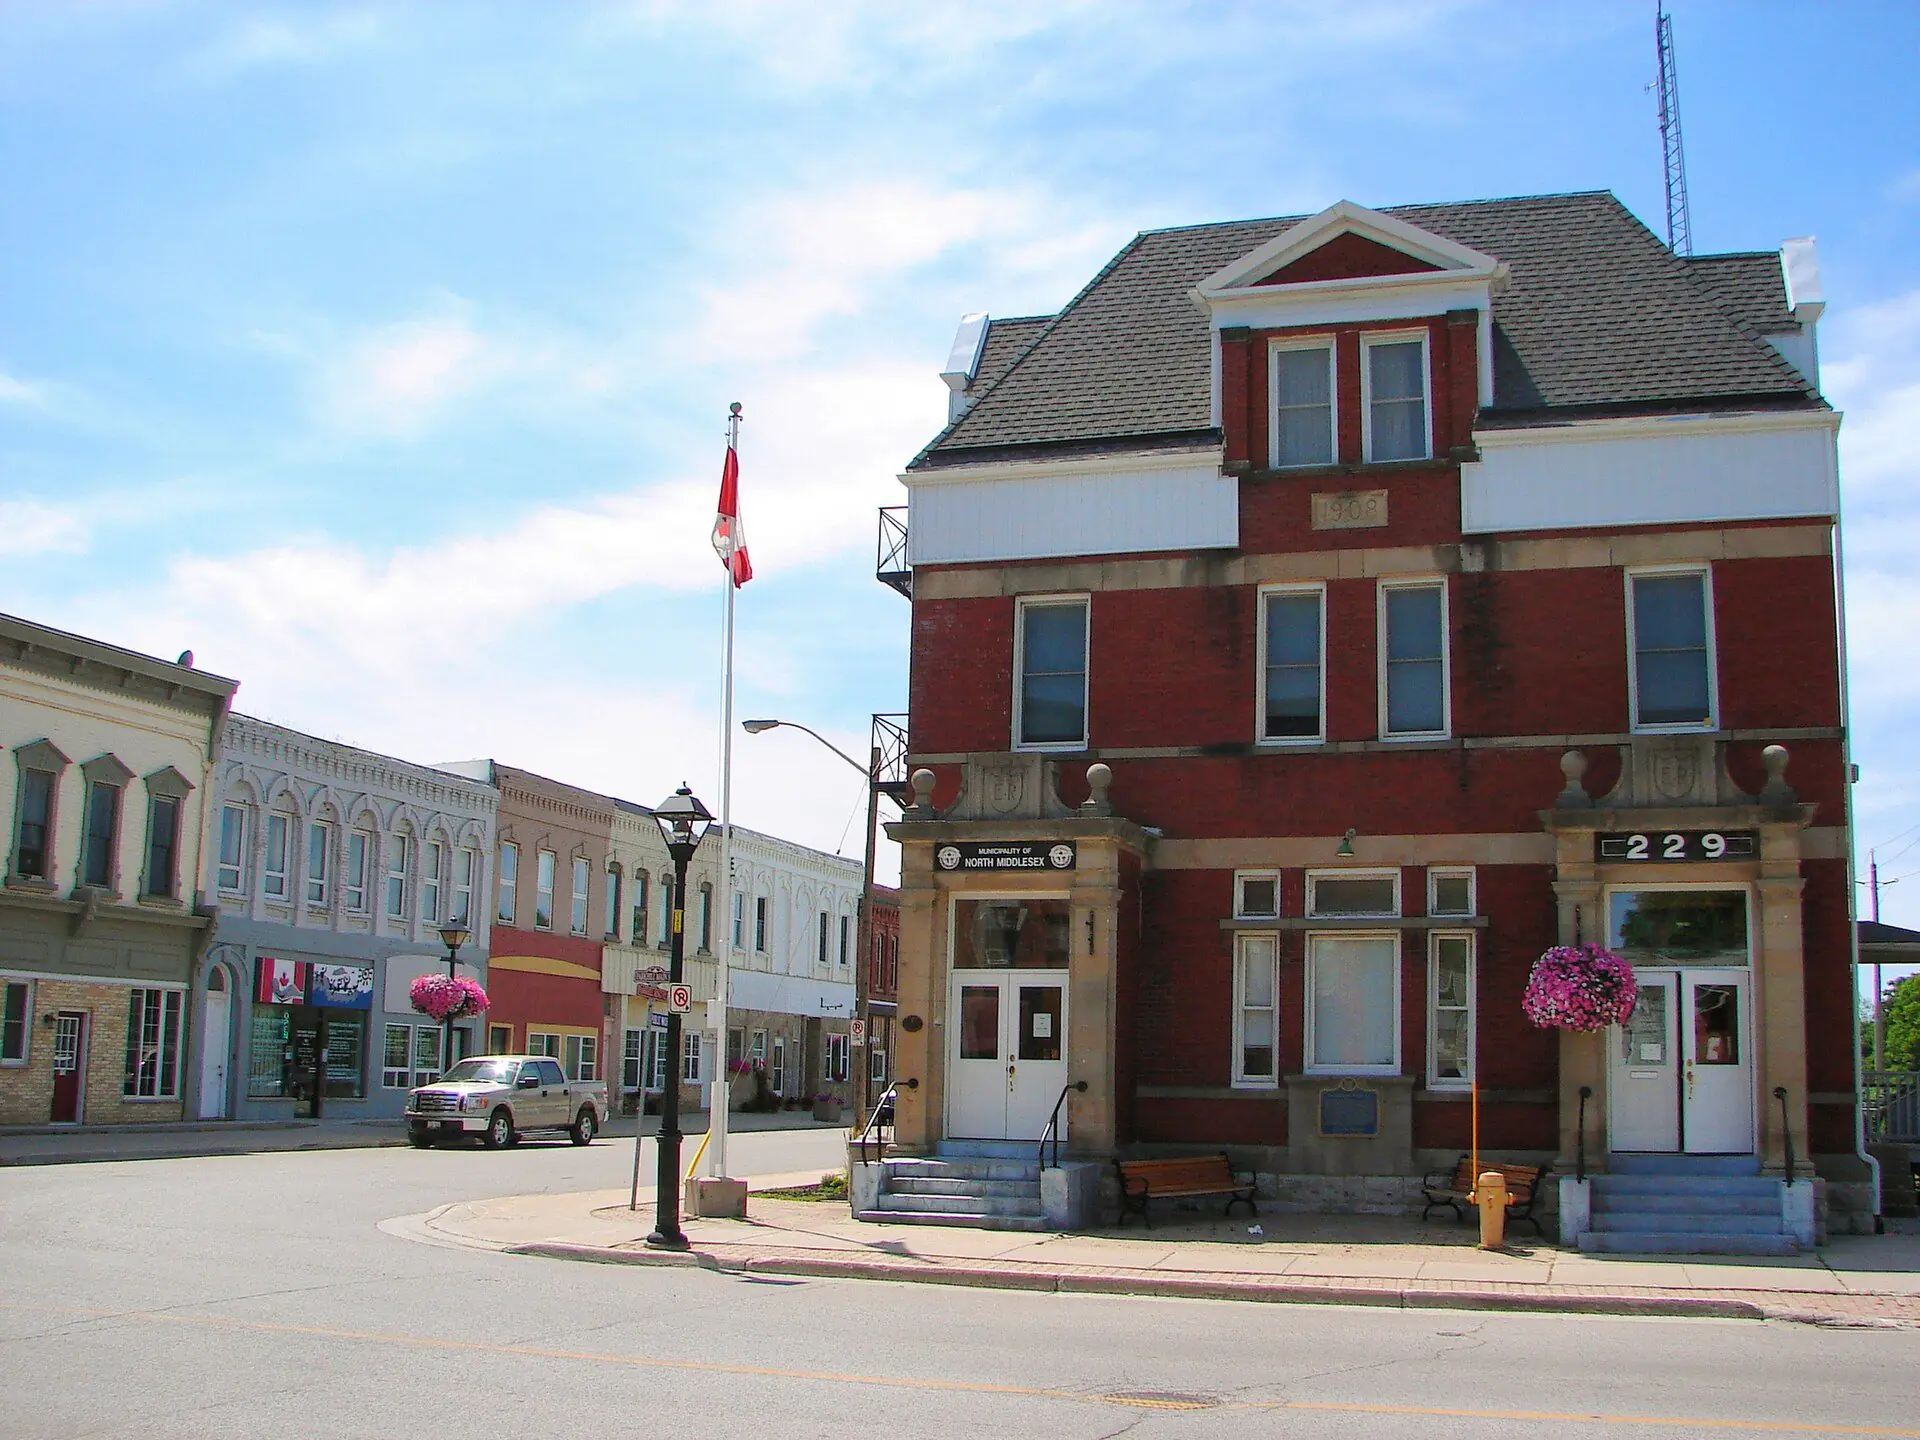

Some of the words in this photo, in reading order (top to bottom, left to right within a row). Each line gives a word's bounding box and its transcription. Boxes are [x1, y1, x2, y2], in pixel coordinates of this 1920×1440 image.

[1324, 499, 1378, 521] 1908
[978, 847, 1020, 855] MUNICIPALITY
[1022, 847, 1032, 855] OF
[1626, 833, 1726, 859] 229
[965, 857, 994, 868] NORTH
[996, 857, 1045, 867] MIDDLESEX
